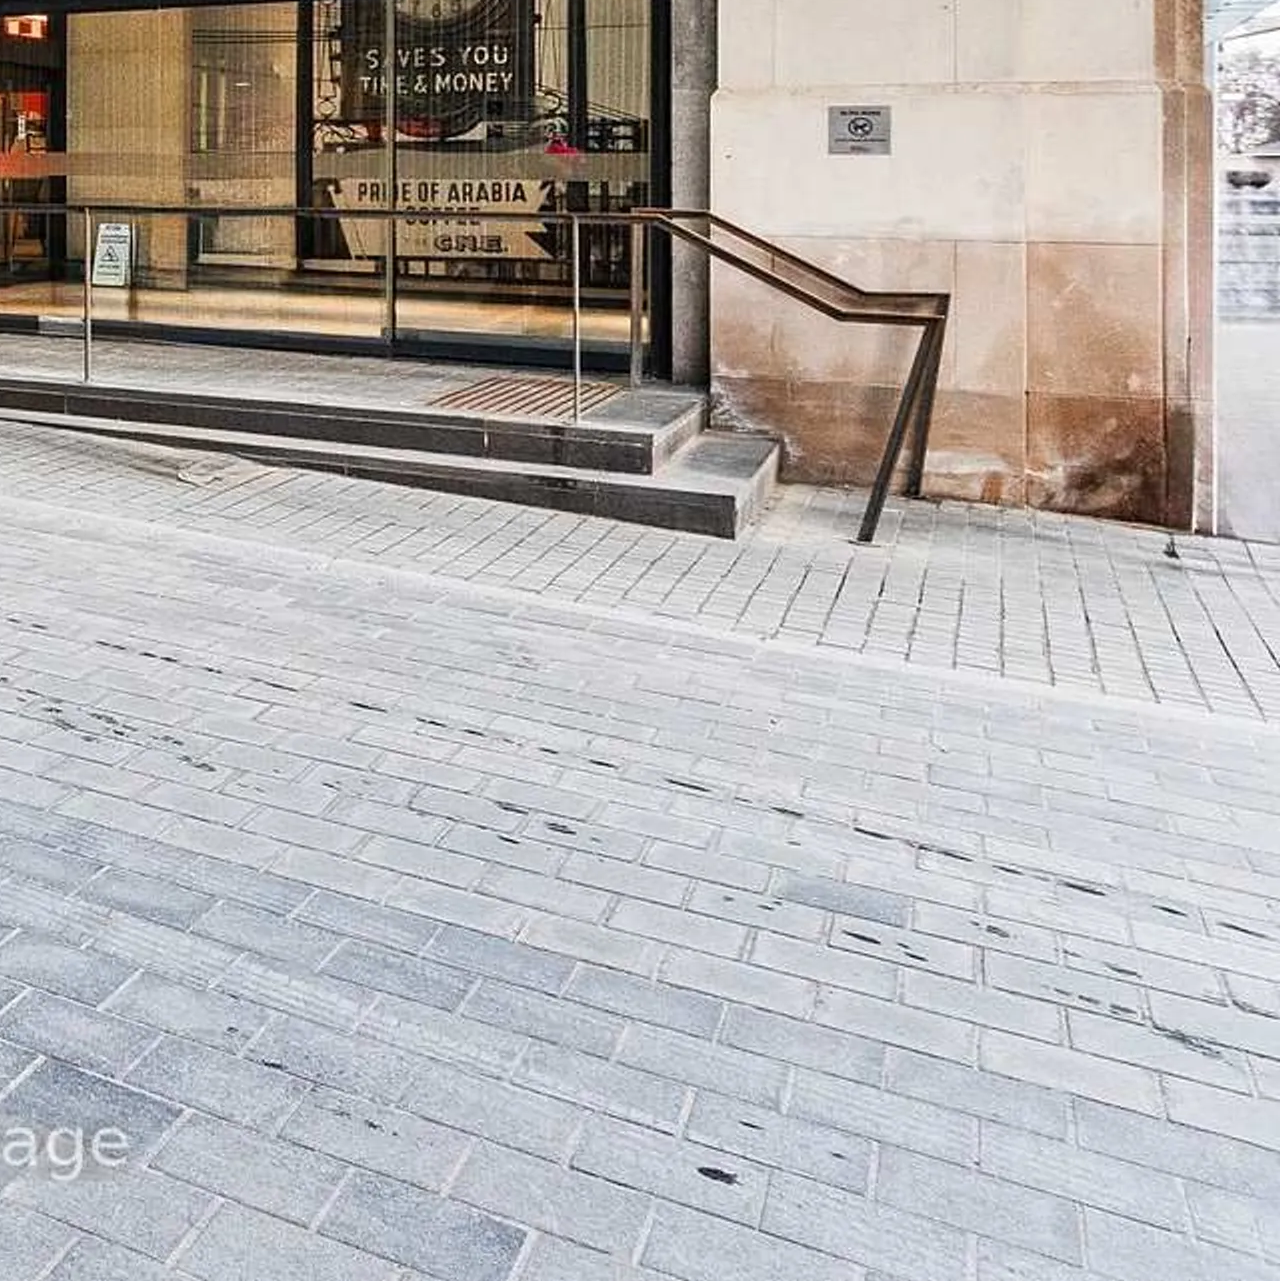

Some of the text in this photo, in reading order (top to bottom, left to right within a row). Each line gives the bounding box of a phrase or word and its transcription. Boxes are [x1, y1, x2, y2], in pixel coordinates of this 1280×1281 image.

[365, 44, 509, 70] SVES YOU
[414, 73, 428, 94] &
[434, 71, 514, 95] MONEY
[357, 180, 528, 203] PRIE OF ARABIA
